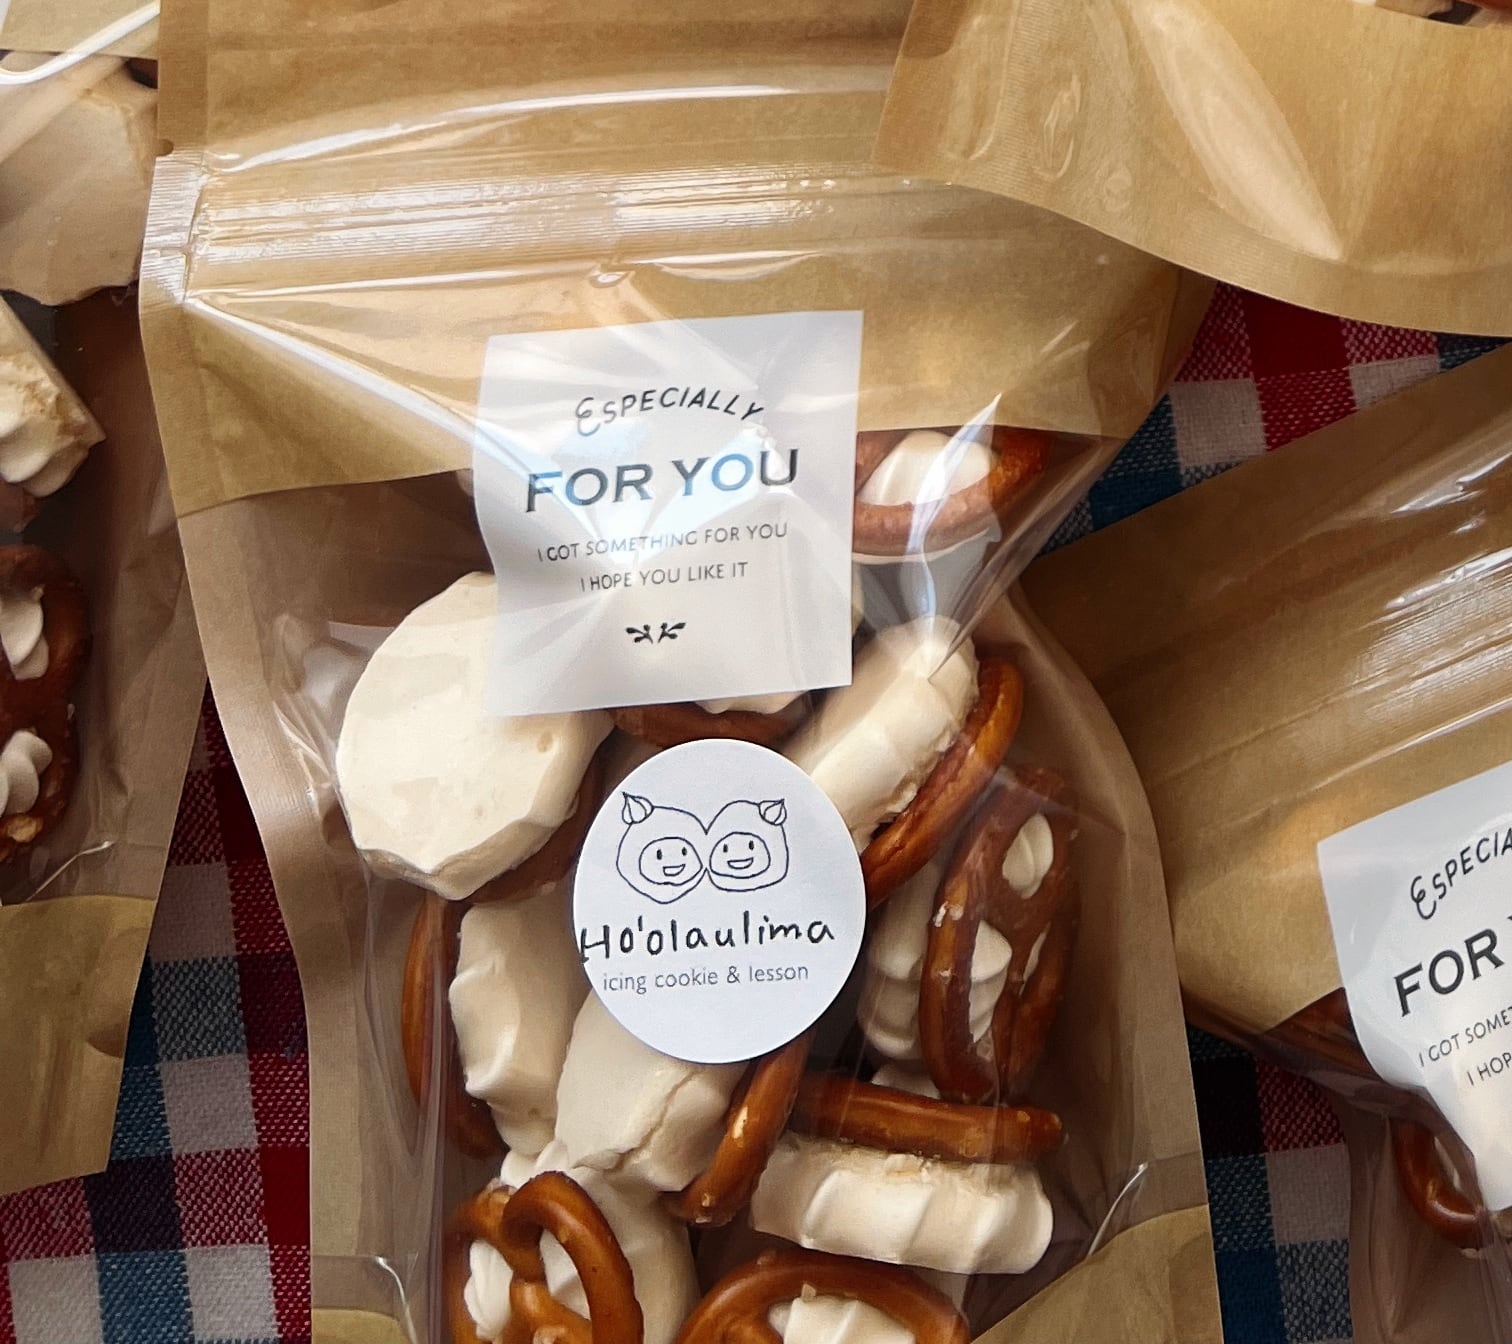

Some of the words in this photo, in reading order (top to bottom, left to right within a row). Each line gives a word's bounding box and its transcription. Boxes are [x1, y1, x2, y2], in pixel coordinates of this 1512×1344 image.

[575, 387, 764, 436] ESPECIALLY
[526, 463, 653, 512] FOR
[672, 449, 799, 496] YOU
[547, 543, 579, 561] GOT
[586, 530, 698, 556] SOMETHING
[705, 527, 740, 544] FOR
[746, 523, 788, 540] YOU
[590, 571, 633, 590] HOPE
[639, 569, 680, 585] YOU
[688, 565, 724, 581] LIKE
[732, 562, 748, 578] IT
[604, 973, 646, 994] icing
[655, 968, 718, 988] cookie
[727, 966, 740, 983] &
[749, 964, 809, 982] lesson
[1393, 928, 1505, 1017] FOR
[1428, 1033, 1460, 1062] GOT
